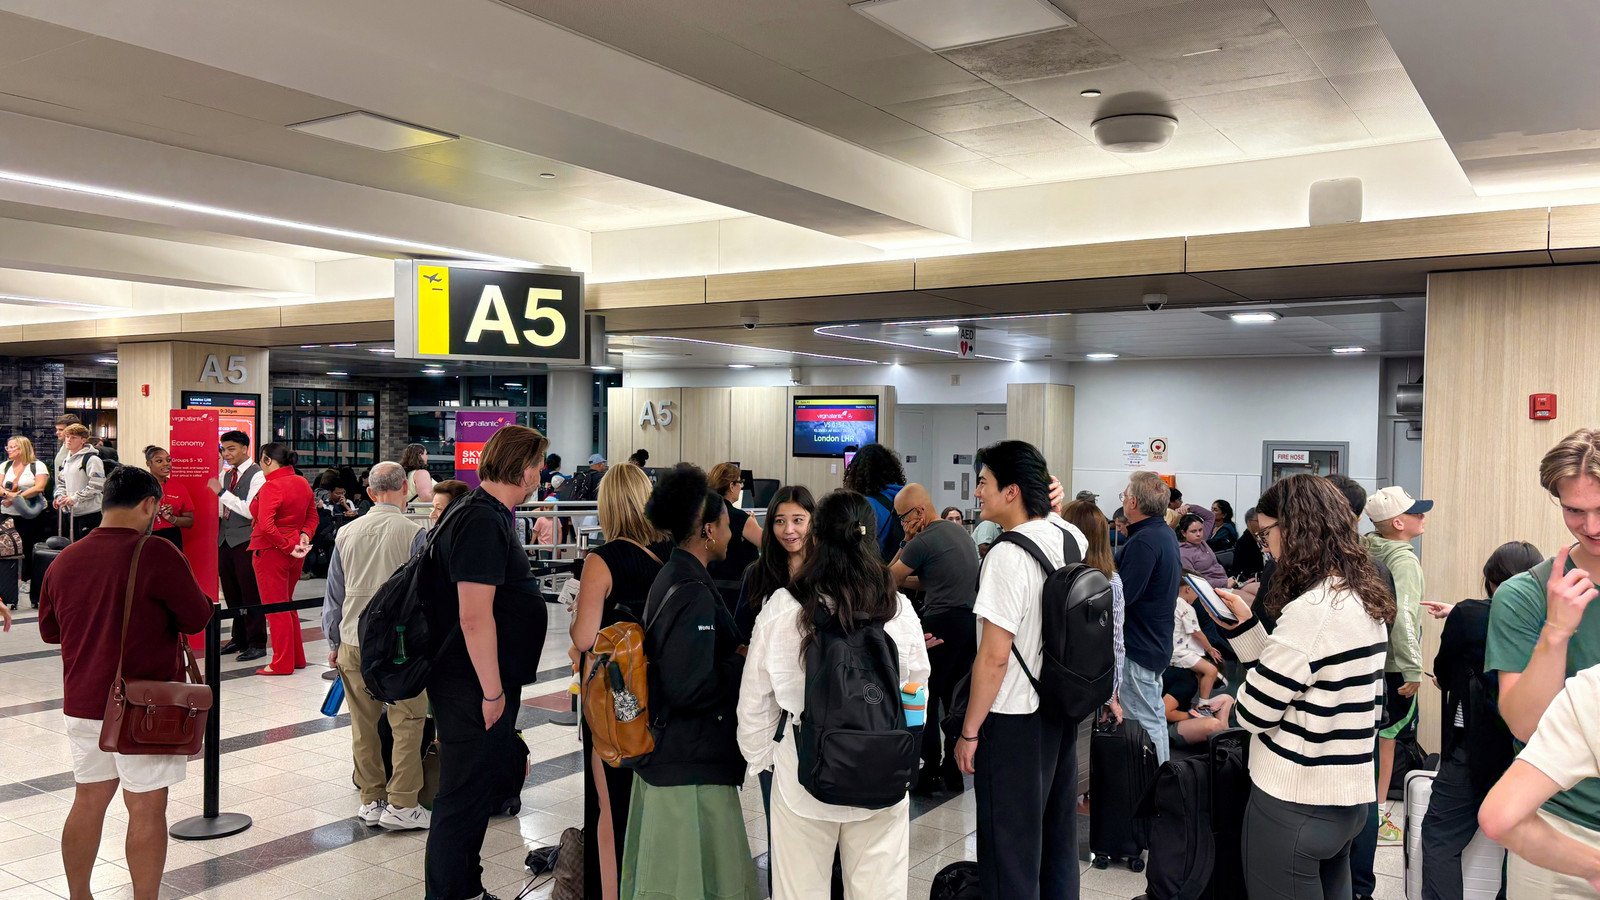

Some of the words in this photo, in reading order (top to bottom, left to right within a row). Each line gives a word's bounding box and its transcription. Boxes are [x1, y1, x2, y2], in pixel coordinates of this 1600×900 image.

[465, 284, 567, 347] A5
[961, 329, 974, 340] AED
[199, 354, 248, 384] A5
[640, 400, 672, 426] A5
[171, 439, 205, 448] Economy
[462, 450, 482, 458] SKY
